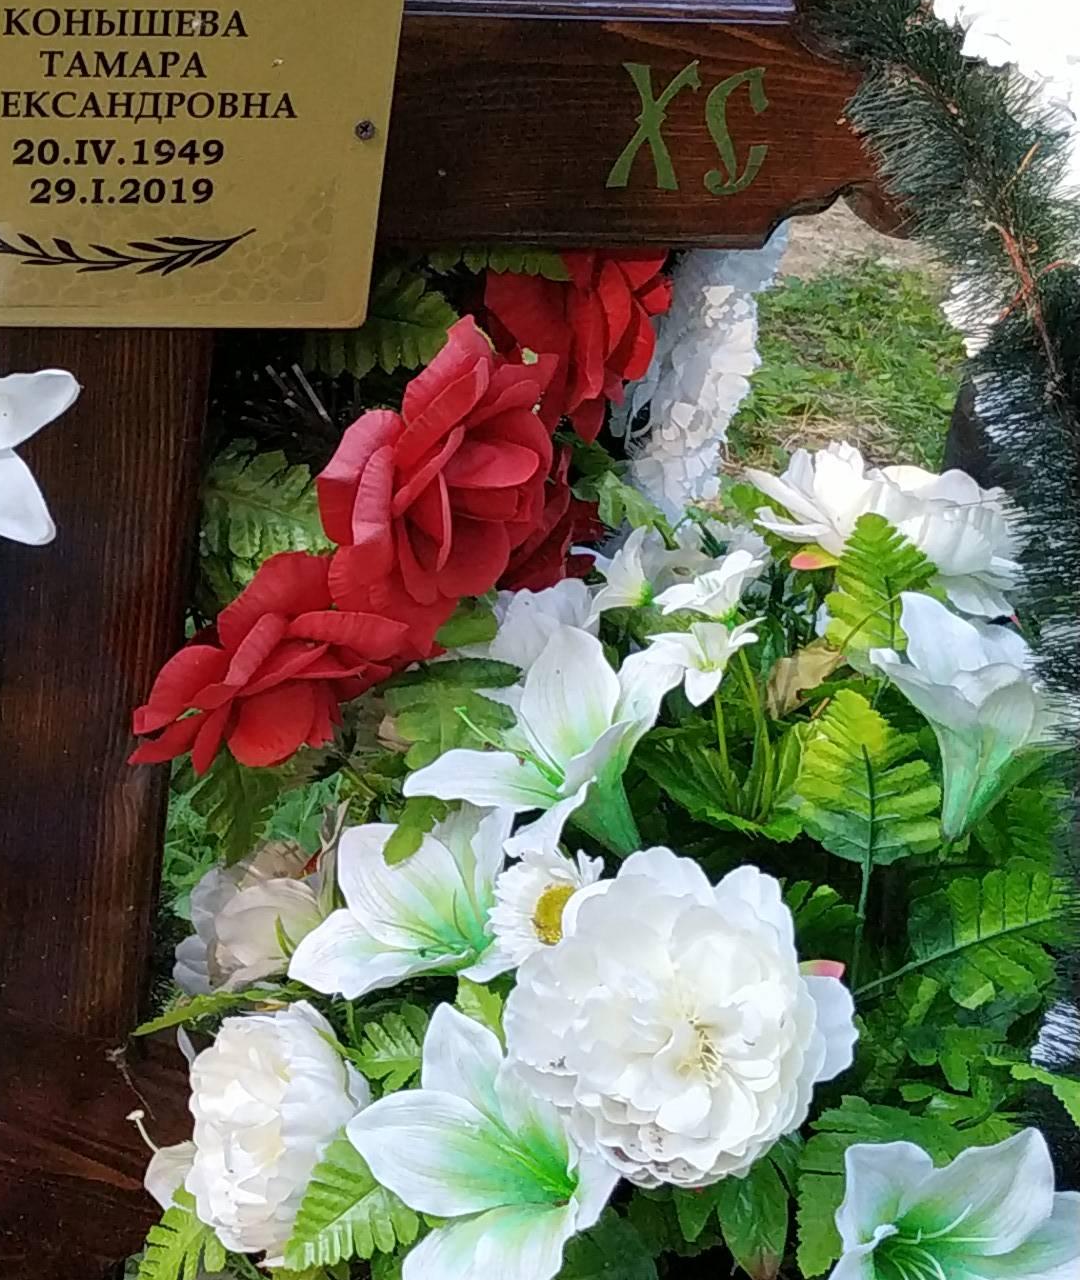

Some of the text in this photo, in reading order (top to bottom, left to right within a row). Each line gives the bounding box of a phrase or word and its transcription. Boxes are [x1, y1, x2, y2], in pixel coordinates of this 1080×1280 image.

[2, 7, 249, 39] КОНЫШЕВА
[39, 50, 207, 79] ТАМАРА
[12, 138, 224, 166] 20.IV.1949
[29, 177, 214, 205] 29.I.2019
